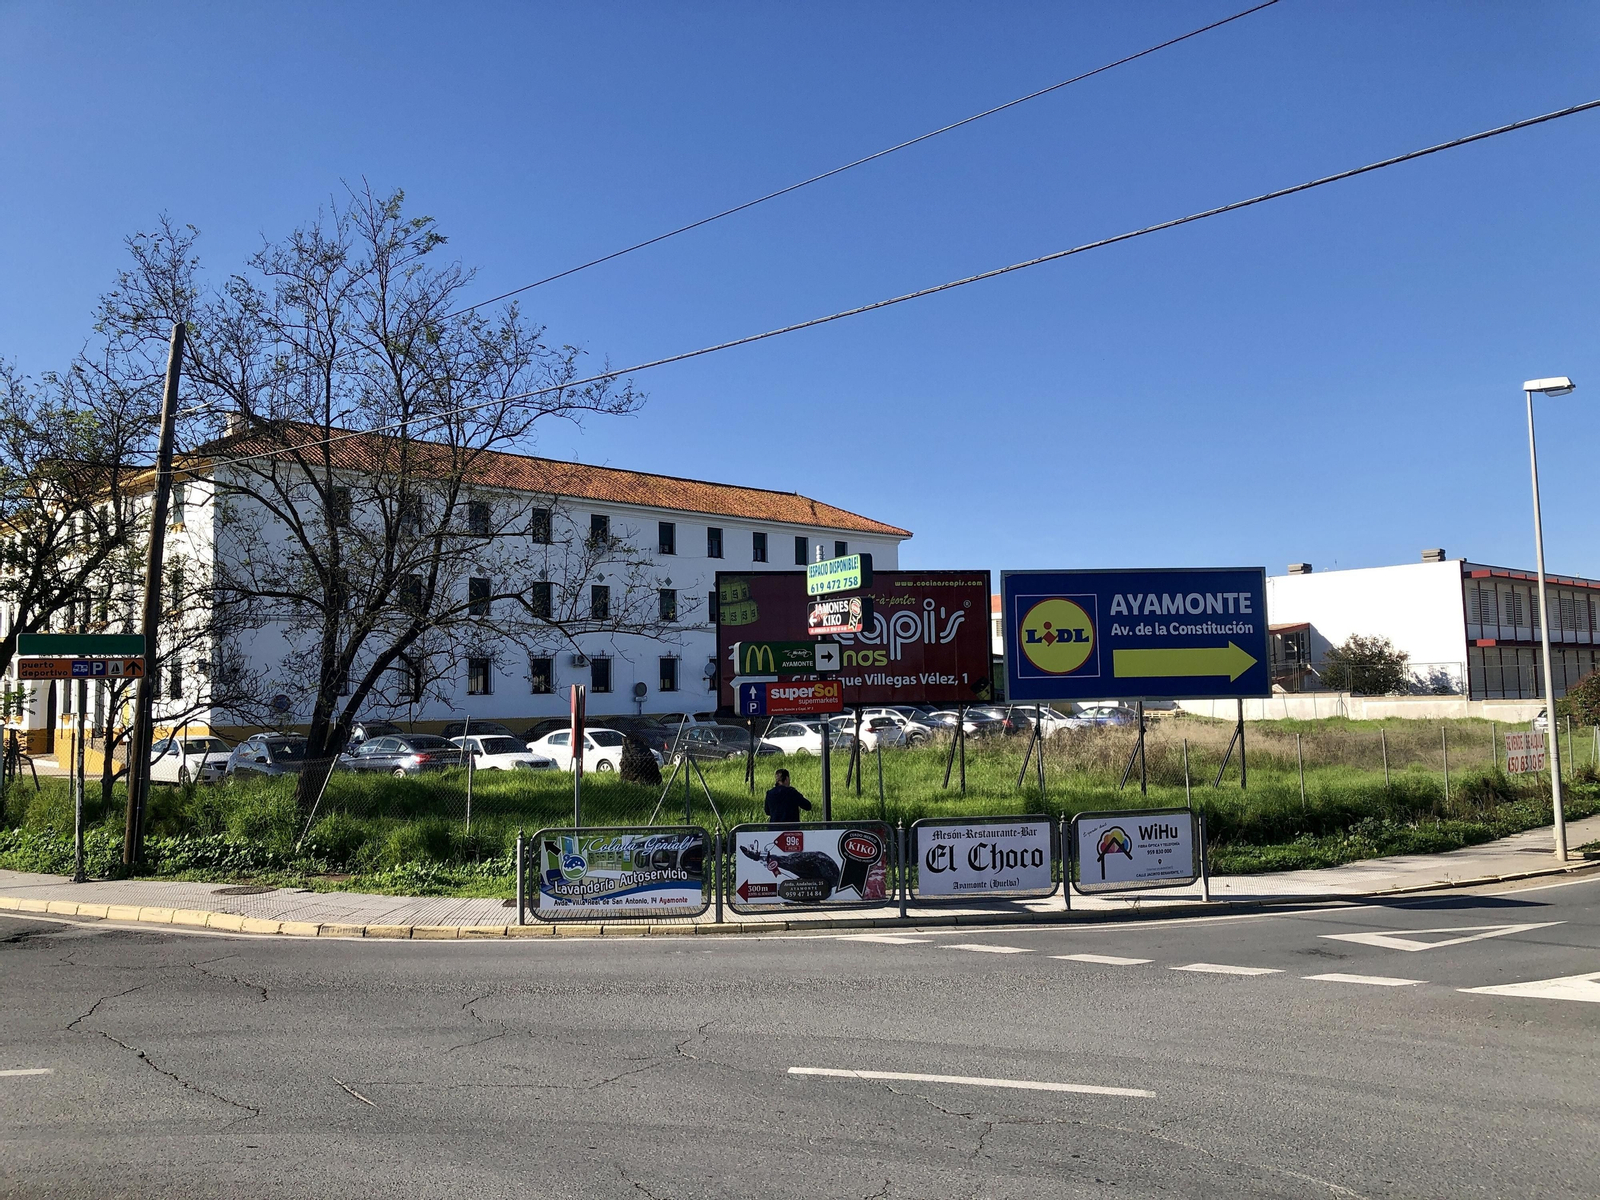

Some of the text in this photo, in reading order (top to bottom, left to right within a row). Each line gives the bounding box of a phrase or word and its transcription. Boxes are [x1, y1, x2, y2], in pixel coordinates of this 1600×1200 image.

[810, 575, 859, 594] 619 472 758
[894, 580, 983, 588] www.cocinascapis.com
[815, 600, 849, 614] JAMONES
[1110, 592, 1253, 616] AYAMONTE
[823, 614, 842, 626] KIKO
[1111, 621, 1254, 636] Av. de la Constitución
[22, 661, 54, 670] puerto
[22, 669, 68, 678] deportivo
[865, 673, 917, 688] Villegas
[919, 673, 959, 685] Vélez,
[962, 673, 969, 684] 1
[770, 683, 838, 700] superSol
[798, 697, 838, 706] supermarkets
[932, 826, 1038, 841] Mesón-Restaurante-Bar
[1138, 823, 1178, 840] WiHu
[848, 841, 876, 856] KIKO
[925, 842, 1044, 875] El Choco
[554, 868, 688, 895] Lavandería Autoservicio
[953, 877, 1020, 890] Ayamonte (Huelva)
[659, 896, 688, 904] Ayamonte
